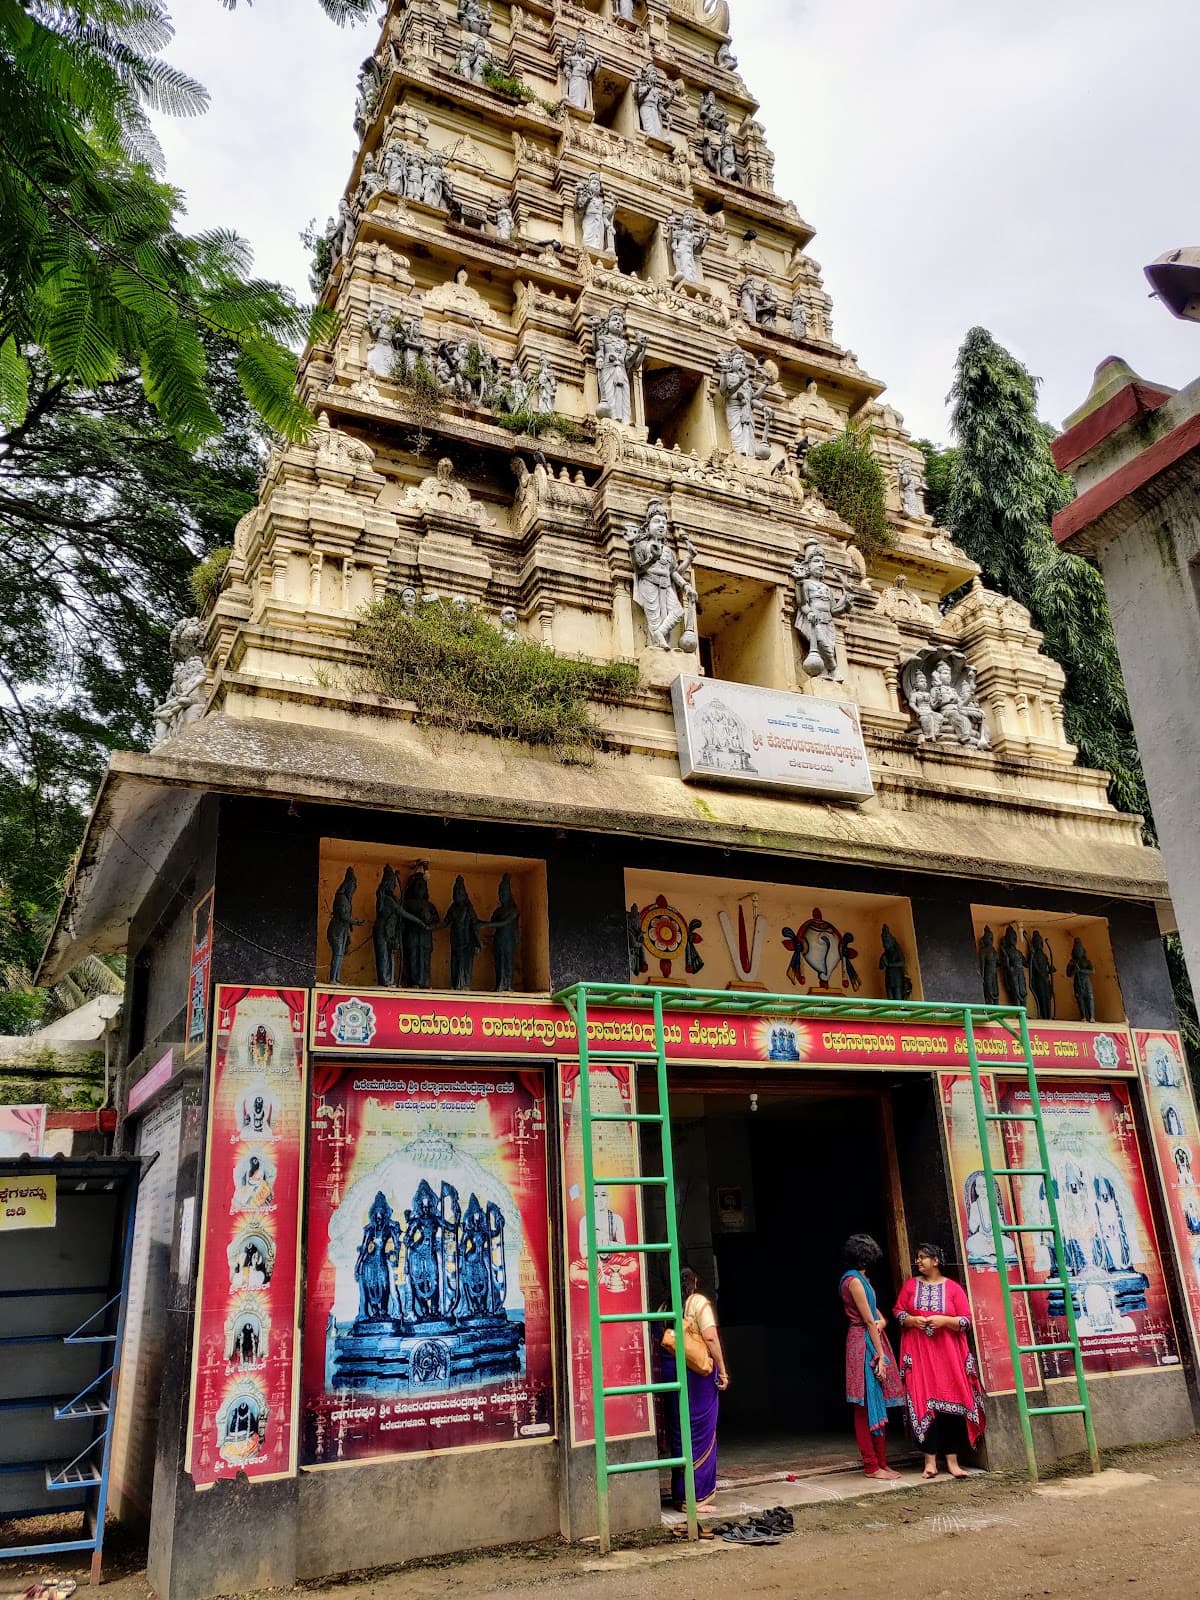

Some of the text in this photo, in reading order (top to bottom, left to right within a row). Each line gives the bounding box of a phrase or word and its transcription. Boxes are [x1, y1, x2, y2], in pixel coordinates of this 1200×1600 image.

[398, 1011, 473, 1037] ರಾಮಾಯ
[481, 1012, 577, 1047] ರಾಮಭದ್ರಾಯ
[688, 1019, 737, 1049] ವೇಧಸೇ
[821, 1029, 896, 1055] ರಘುನಾಥಾಯ
[900, 1034, 949, 1056] ನಾಥಾಯ
